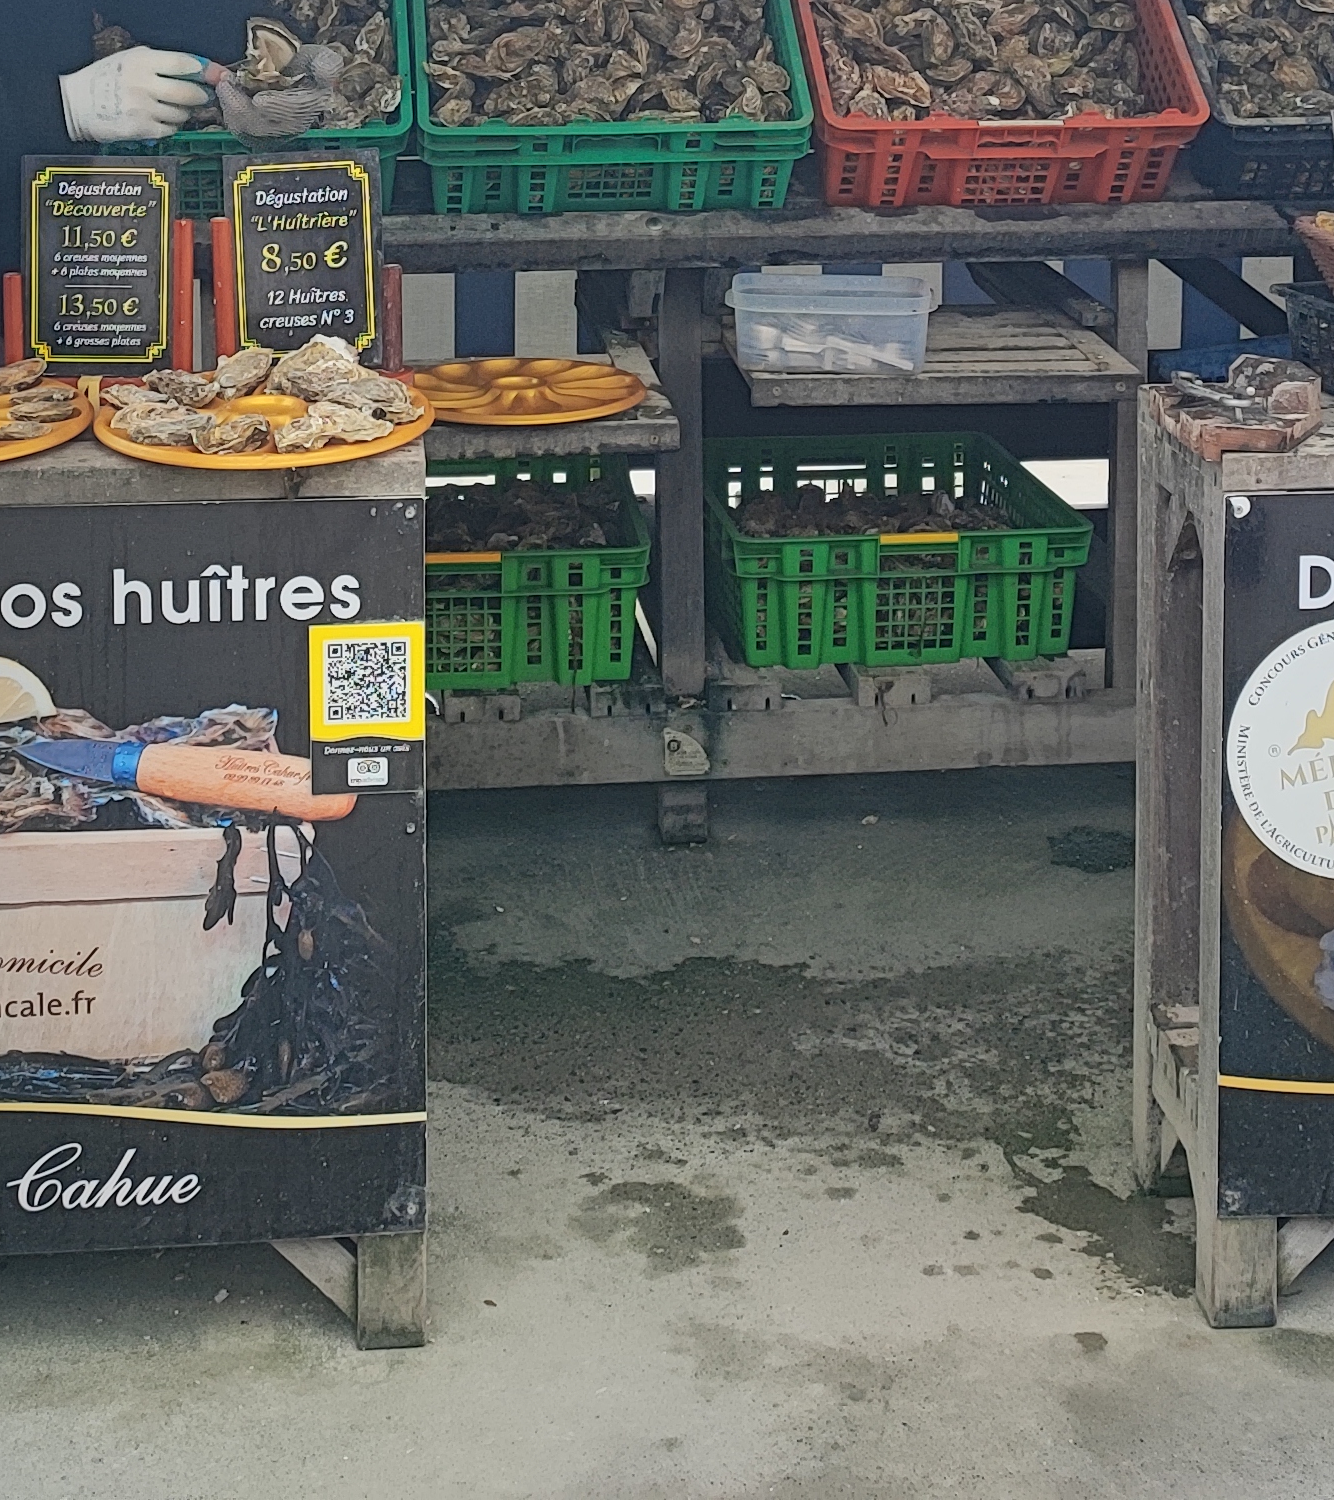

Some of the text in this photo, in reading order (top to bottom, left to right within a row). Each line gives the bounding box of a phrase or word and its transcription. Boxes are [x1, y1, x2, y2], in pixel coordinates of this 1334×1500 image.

[58, 181, 142, 198] Dégustation
[256, 185, 348, 208] Dégustation
[61, 225, 116, 251] 11,50
[261, 243, 316, 275] 8,50
[267, 288, 347, 306] 12 Huîtres
[260, 315, 317, 329] creuses
[113, 565, 361, 625] huîtres
[1248, 646, 1306, 707] CONCOURS
[6, 1143, 201, 1215] Cahue
